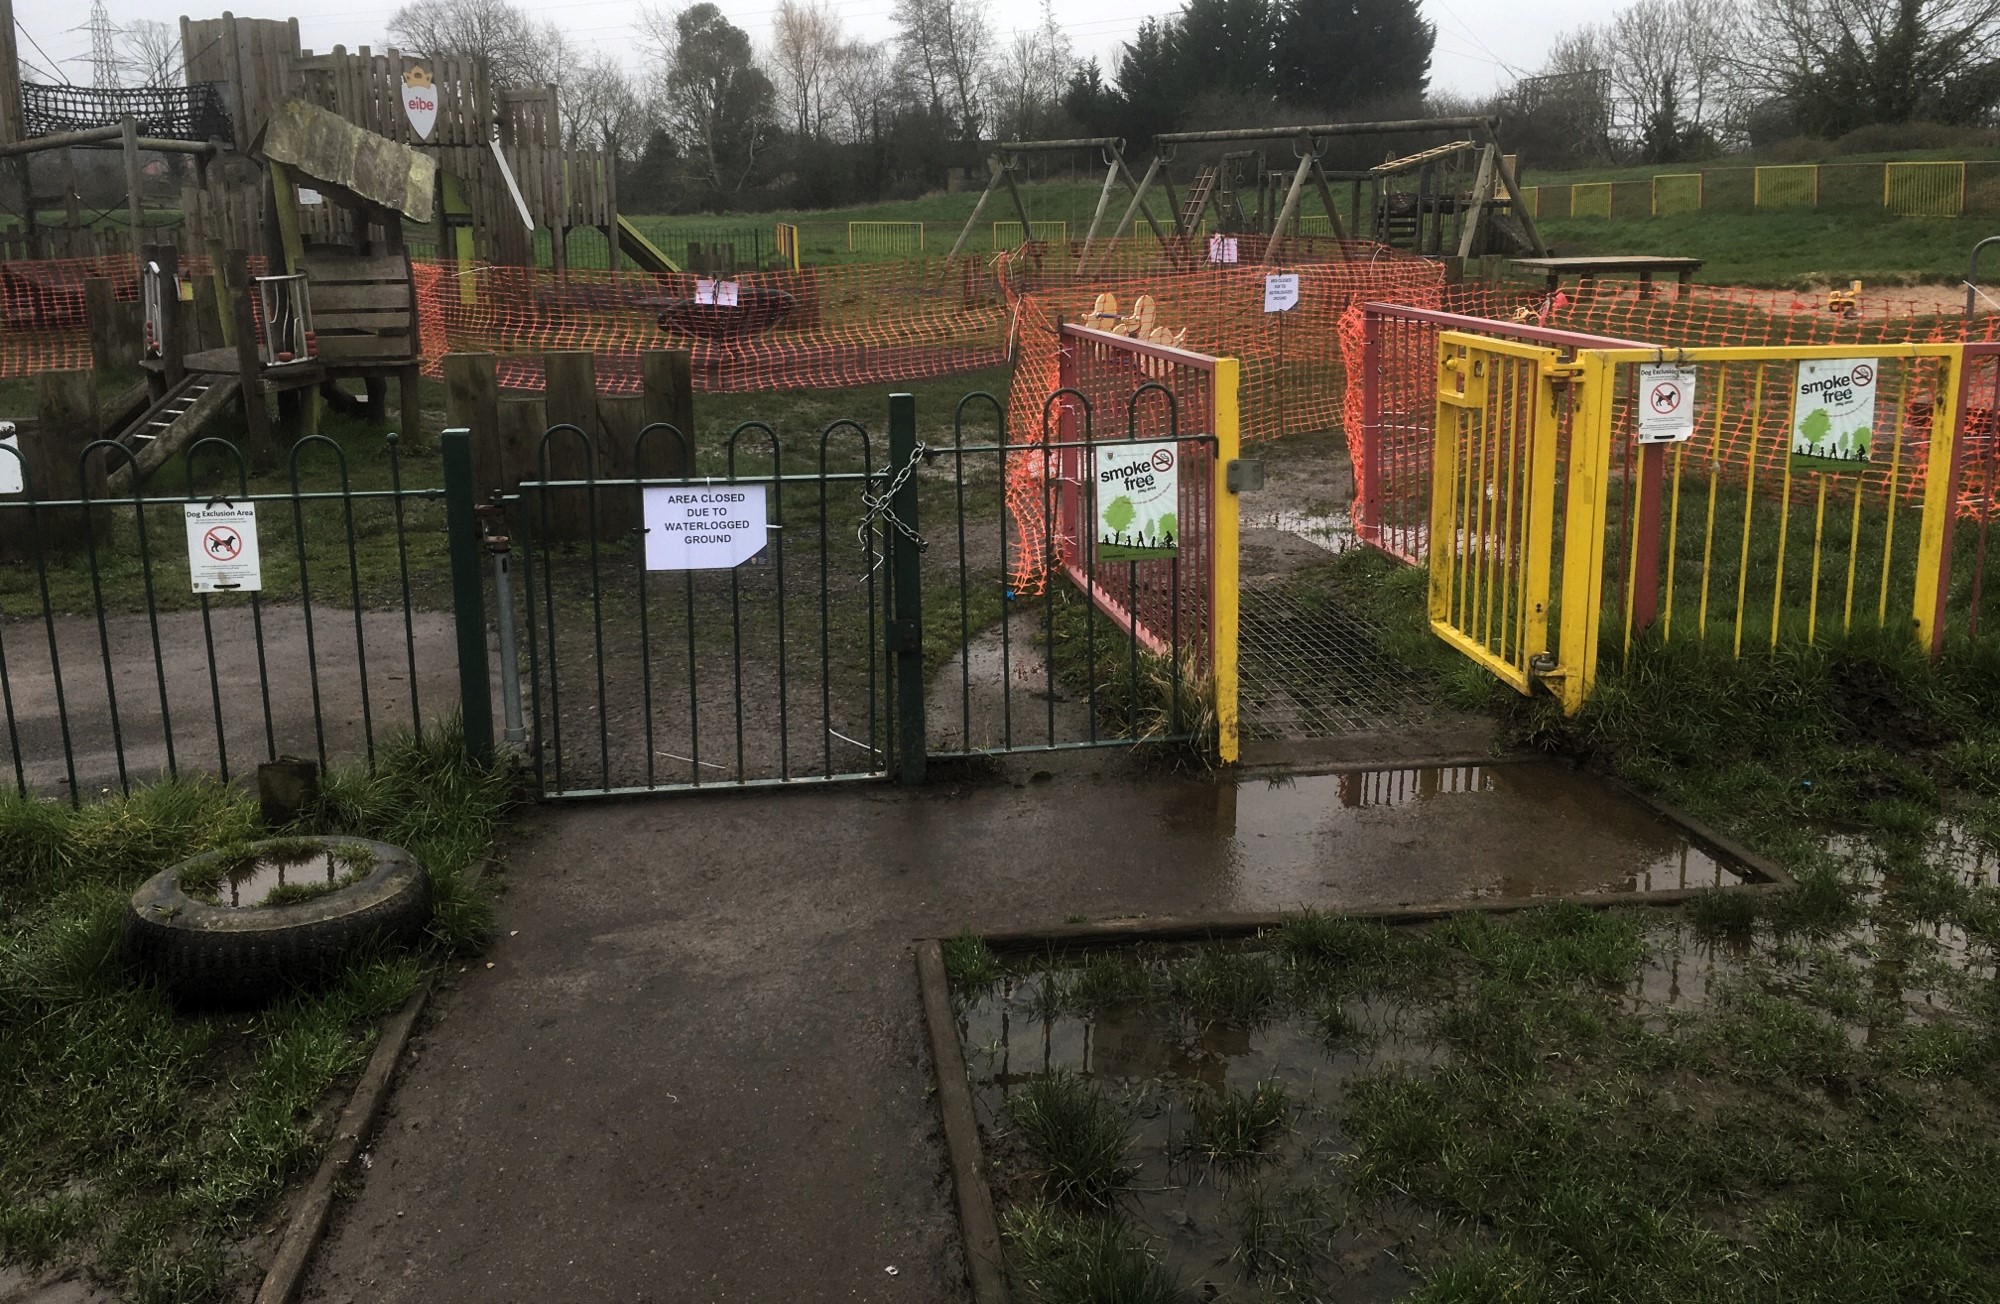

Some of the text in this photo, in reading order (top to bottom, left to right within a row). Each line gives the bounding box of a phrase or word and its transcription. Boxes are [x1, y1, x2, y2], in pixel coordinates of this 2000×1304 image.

[409, 96, 434, 110] eibe
[1801, 375, 1850, 395] smoke
[1823, 388, 1852, 403] free
[1101, 461, 1151, 483] smoke
[1124, 474, 1154, 491] free
[668, 493, 745, 504] AREA CLOSED
[687, 507, 727, 517] DUE TO
[665, 520, 750, 531] WATERLOGGED
[684, 534, 731, 544] GROUND
